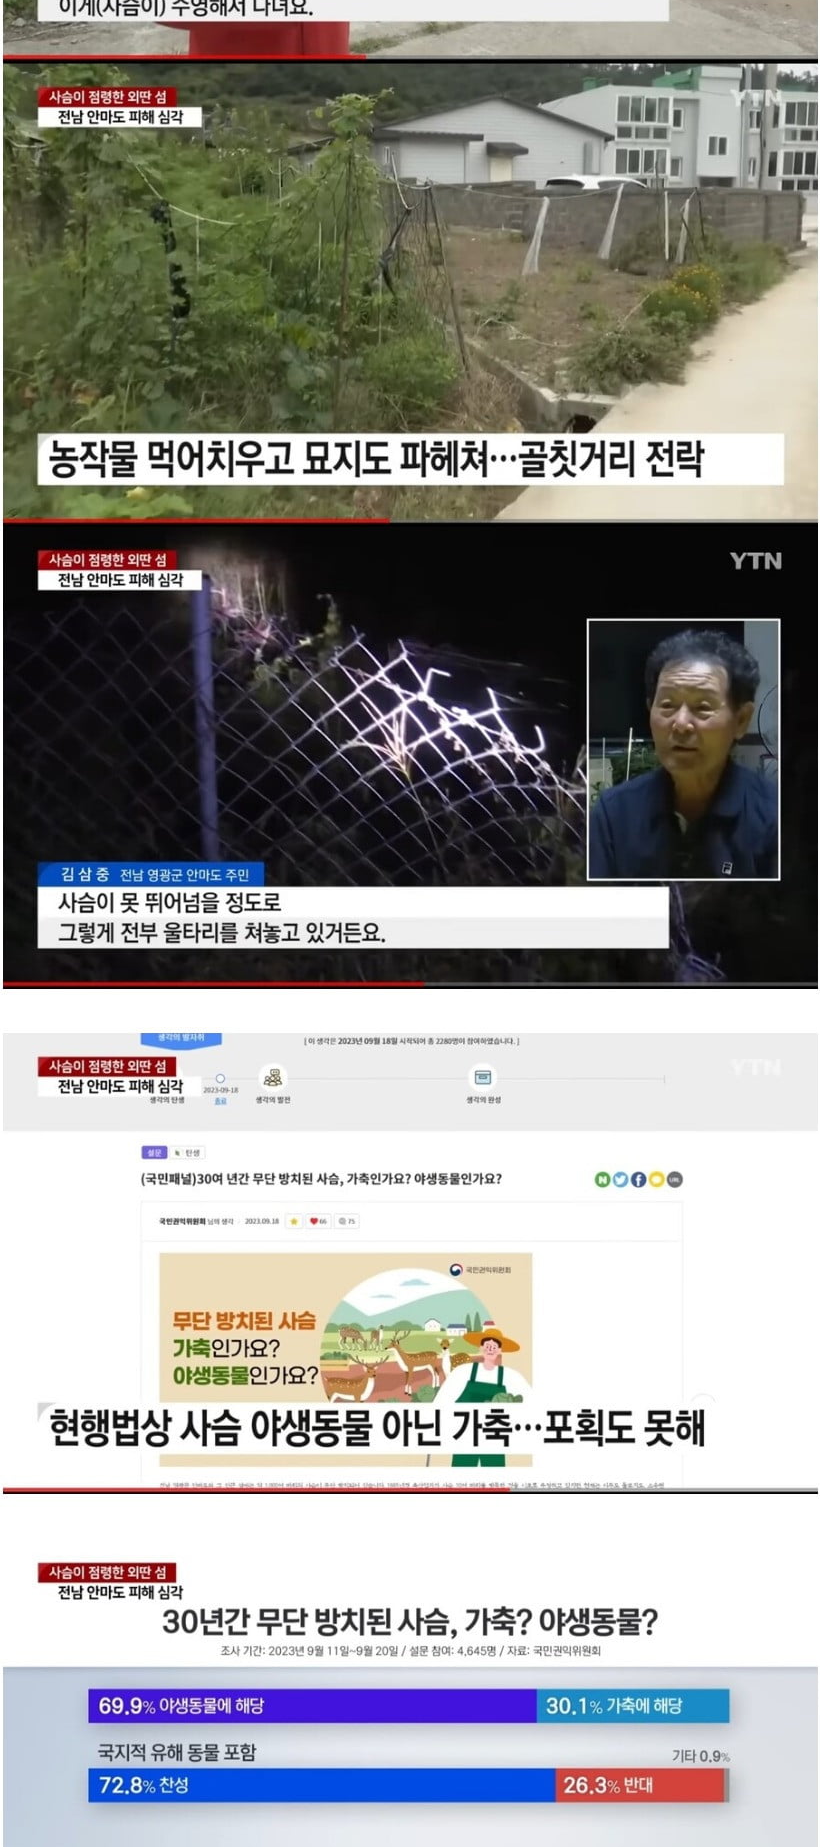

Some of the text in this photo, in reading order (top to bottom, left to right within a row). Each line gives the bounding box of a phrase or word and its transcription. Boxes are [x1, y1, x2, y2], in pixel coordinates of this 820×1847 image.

[140, 1172, 503, 1187] (국민패널)30여 년간 무단 방치된 사슴, 가축인가요? 야생동물인가요?
[172, 1310, 317, 1332] 무단 방치된 사슴
[173, 1337, 281, 1359] 가축인가요?
[173, 1365, 319, 1386] 야생동물인가요?
[162, 1605, 659, 1640] 30년간 무단 방치된 사슴, 가축? 야생동물?
[220, 1645, 601, 1658] 조사 기간: 2023년 9월 11일~9월 20일 설문 참여: 4,645명 자료: 국민권익위원회
[97, 1696, 265, 1716] 69.9% 야생동물에 해당
[546, 1696, 683, 1716] 30.1% 가축에 해당
[97, 1743, 257, 1763] 국지적 유해 동물 포함
[672, 1749, 731, 1764] 기타 0.9%
[99, 1775, 189, 1795] 72.8% 찬성
[563, 1776, 653, 1795] 26.3% 반대
